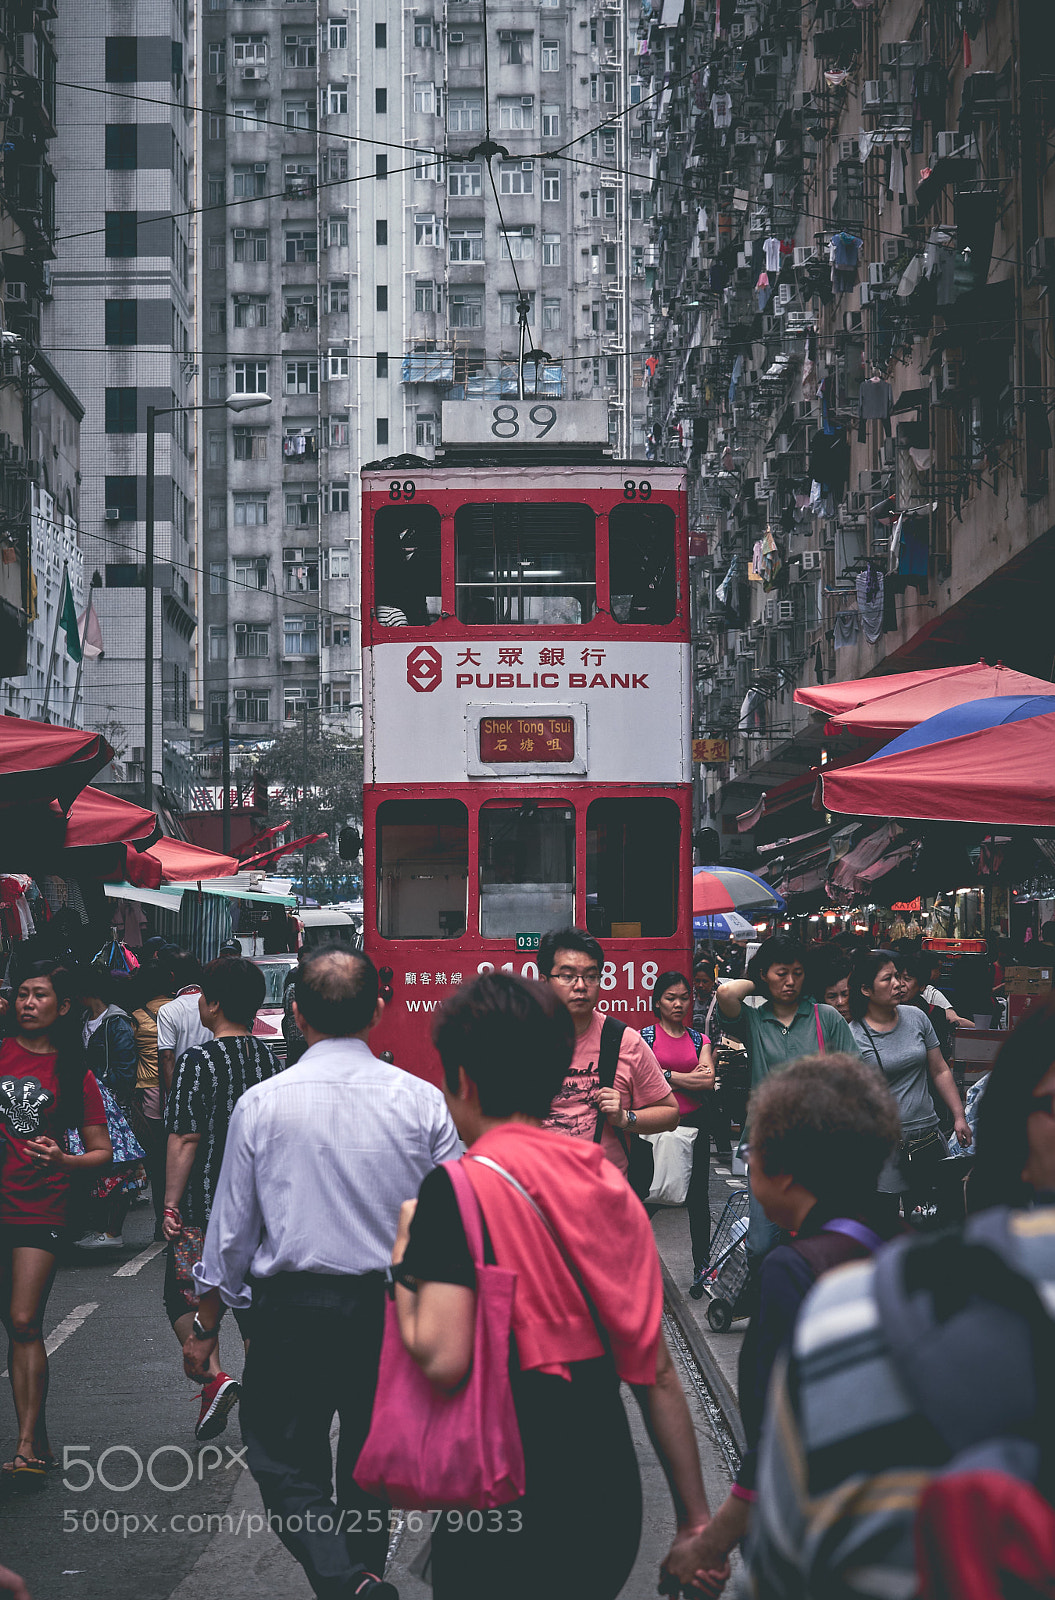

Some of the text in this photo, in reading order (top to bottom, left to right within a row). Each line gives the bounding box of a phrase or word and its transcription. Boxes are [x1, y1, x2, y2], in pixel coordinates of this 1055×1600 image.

[491, 404, 557, 439] 89
[389, 480, 416, 501] 89
[623, 480, 652, 501] 89
[456, 647, 607, 667] 大眾銀行
[456, 672, 650, 689] PUBLIC BANK
[484, 719, 571, 736] Shek Tong Tsui
[493, 738, 563, 752] 石塘咀
[518, 936, 539, 947] 039
[405, 971, 463, 985] 顧客熱線
[600, 961, 659, 991] 818
[405, 995, 653, 1013] ww om.h
